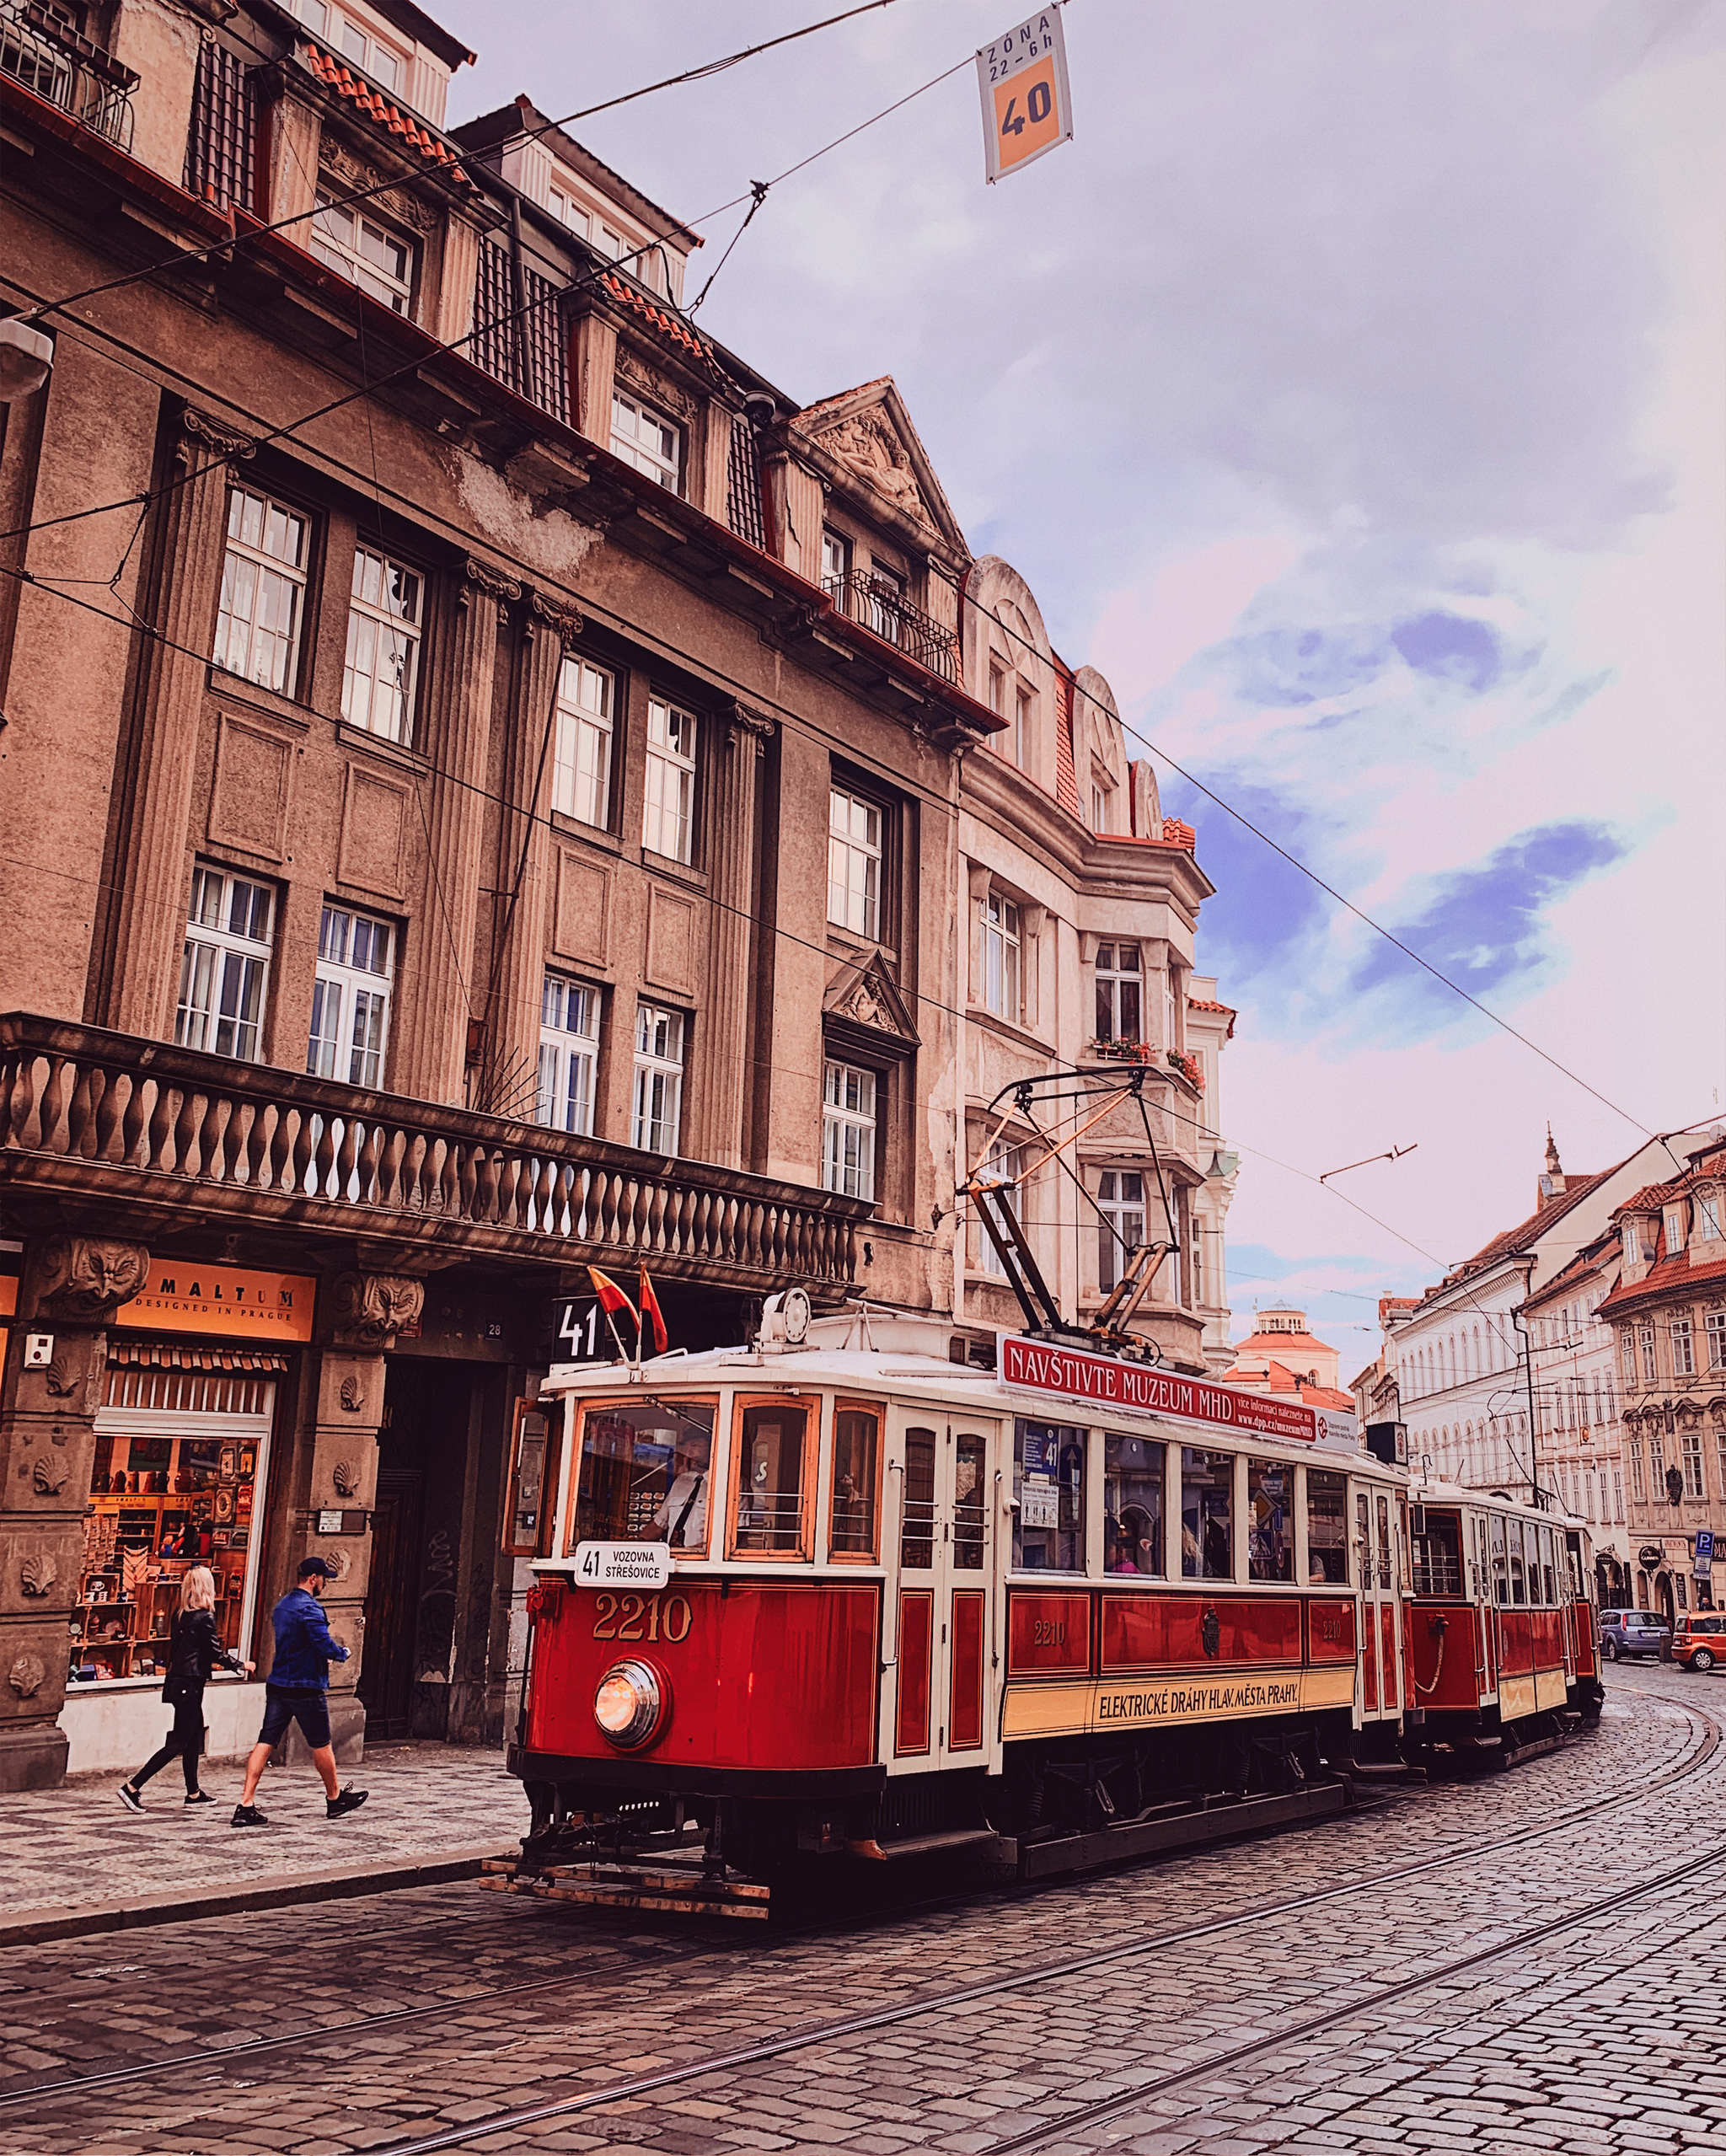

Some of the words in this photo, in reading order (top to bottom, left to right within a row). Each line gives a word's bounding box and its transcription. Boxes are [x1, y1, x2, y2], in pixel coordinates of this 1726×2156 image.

[987, 15, 1049, 64] ZÓNA
[1001, 81, 1052, 136] 40
[142, 1278, 294, 1307] MALTUM
[136, 1298, 209, 1312] DESIGNED
[217, 1306, 232, 1315] IN
[241, 1309, 292, 1322] PRAGUE
[489, 1324, 501, 1336] 28
[559, 1304, 597, 1356] 41
[1010, 1347, 1117, 1398] NAVŠTIVTE
[1123, 1371, 1193, 1414] MUZEUM
[1198, 1387, 1233, 1422] MHD
[1046, 1442, 1057, 1467] 41
[1699, 1533, 1710, 1548] P
[582, 1550, 600, 1577] 41
[613, 1551, 655, 1563] VOZOVNA
[605, 1564, 661, 1579] STŘEŠOVICE
[593, 1593, 694, 1643] 2210
[1323, 1620, 1342, 1639] 2210
[1034, 1620, 1064, 1646] 2210
[1099, 1688, 1169, 1719] ELEKTRICKÉ
[1171, 1687, 1209, 1714] DRÁHY
[1267, 1683, 1299, 1704] PRAHY.
